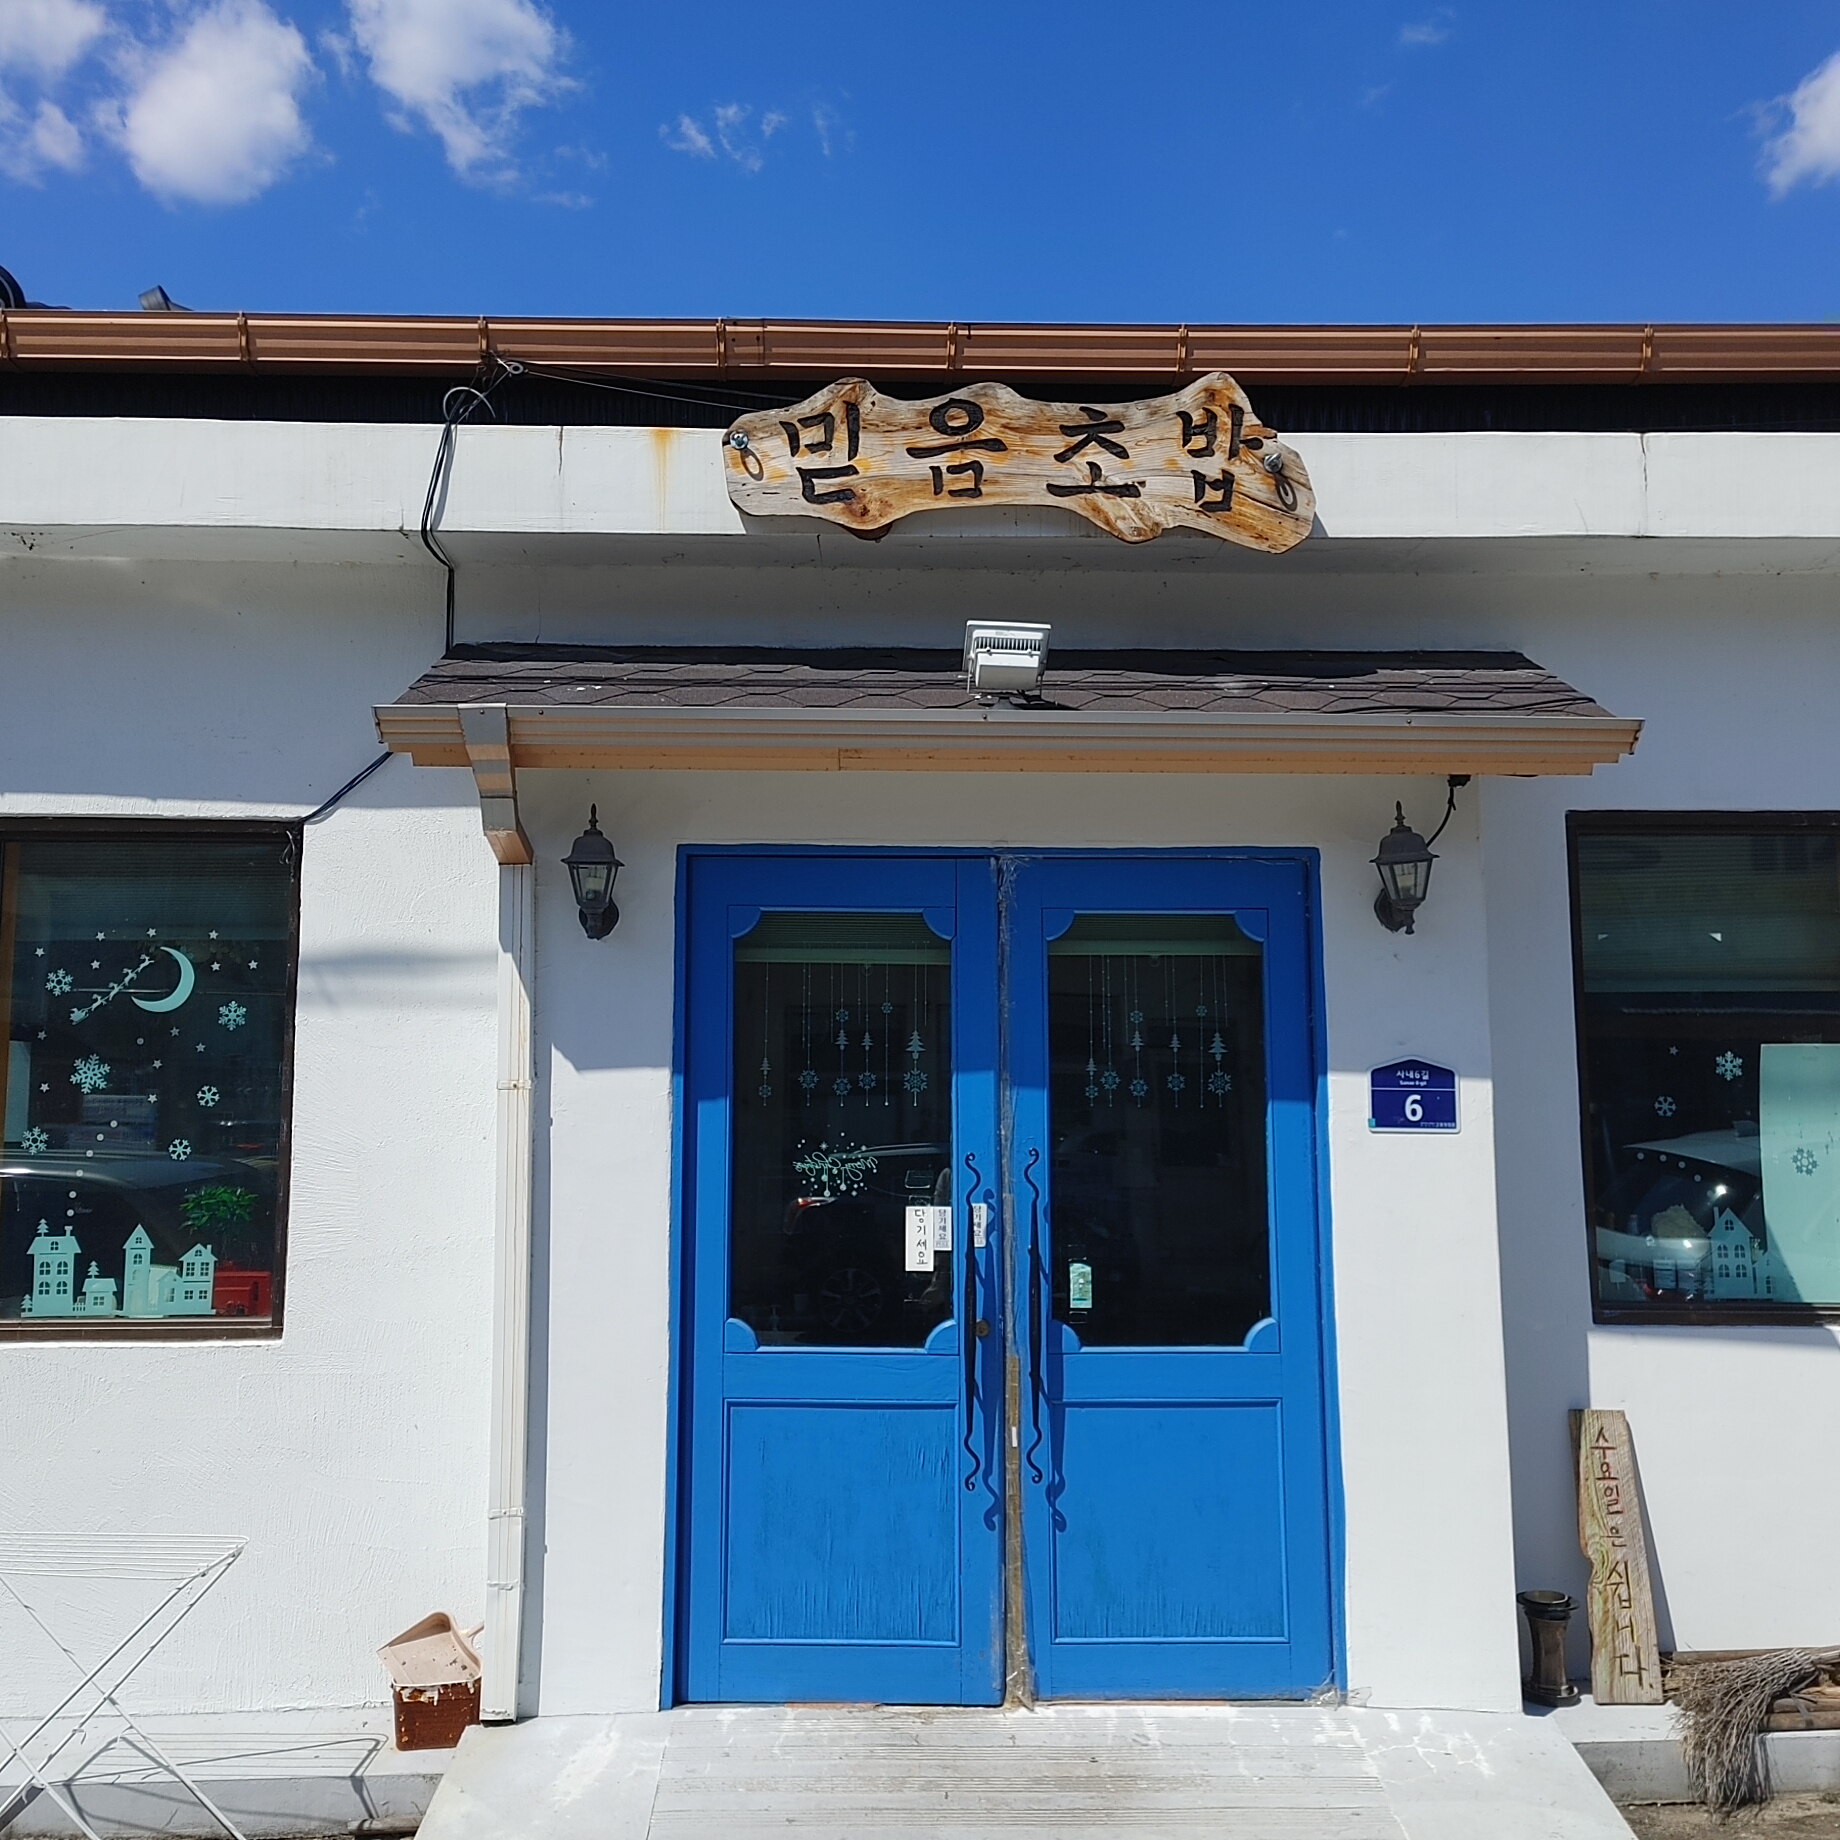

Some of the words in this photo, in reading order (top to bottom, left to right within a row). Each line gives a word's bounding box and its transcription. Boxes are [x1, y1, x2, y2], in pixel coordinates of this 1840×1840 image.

[778, 396, 1278, 513] 믿음초밥
[1404, 1094, 1424, 1122] 6
[914, 1208, 929, 1265] 당기세요
[938, 1208, 947, 1240] 당기세요
[1589, 1426, 1627, 1548] 수요일은
